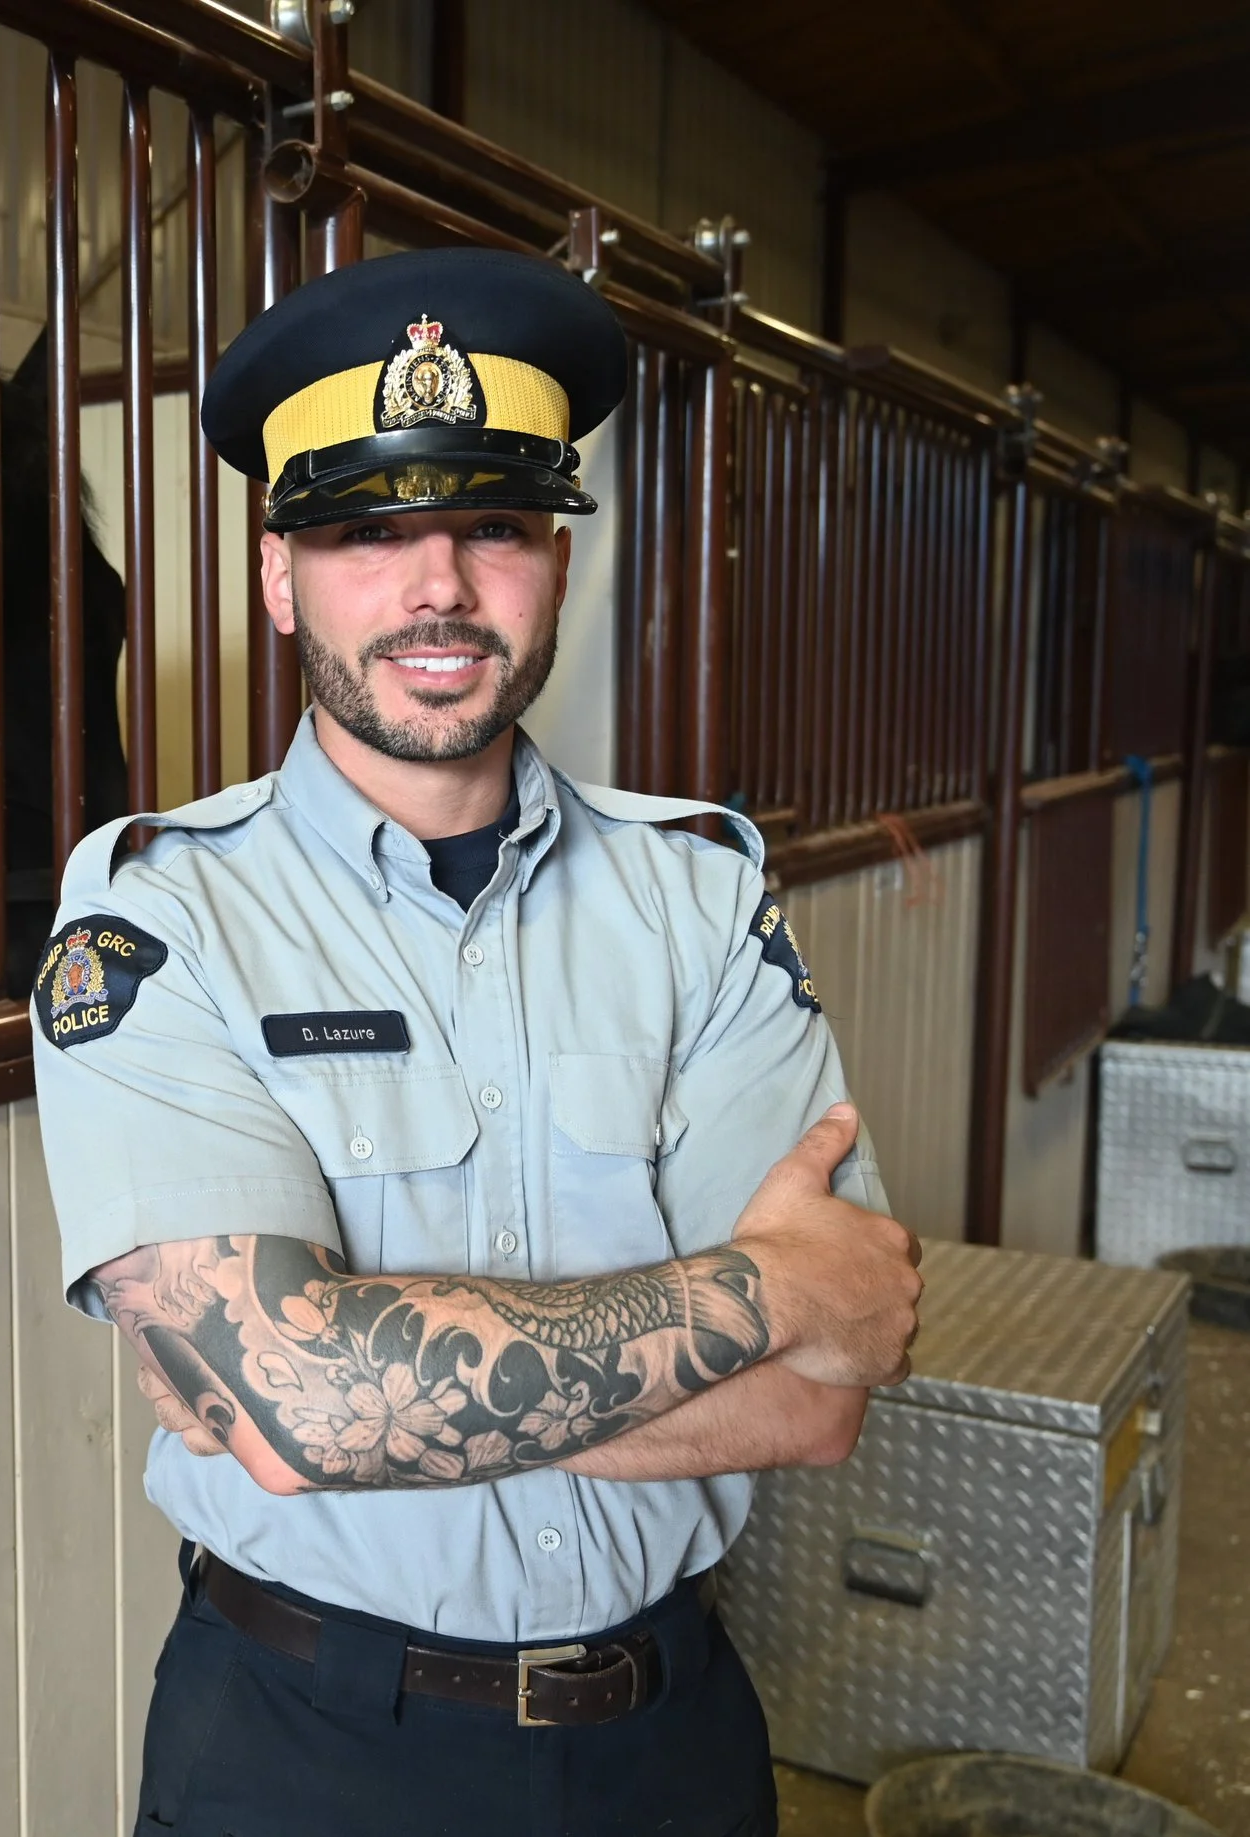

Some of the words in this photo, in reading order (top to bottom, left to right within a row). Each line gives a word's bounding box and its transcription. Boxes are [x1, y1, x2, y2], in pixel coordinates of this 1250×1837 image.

[97, 931, 136, 957] GRC
[37, 943, 63, 991] RCMP
[52, 1004, 110, 1040] POLICE
[301, 1027, 319, 1041] D.
[323, 1026, 376, 1041] Lazure
